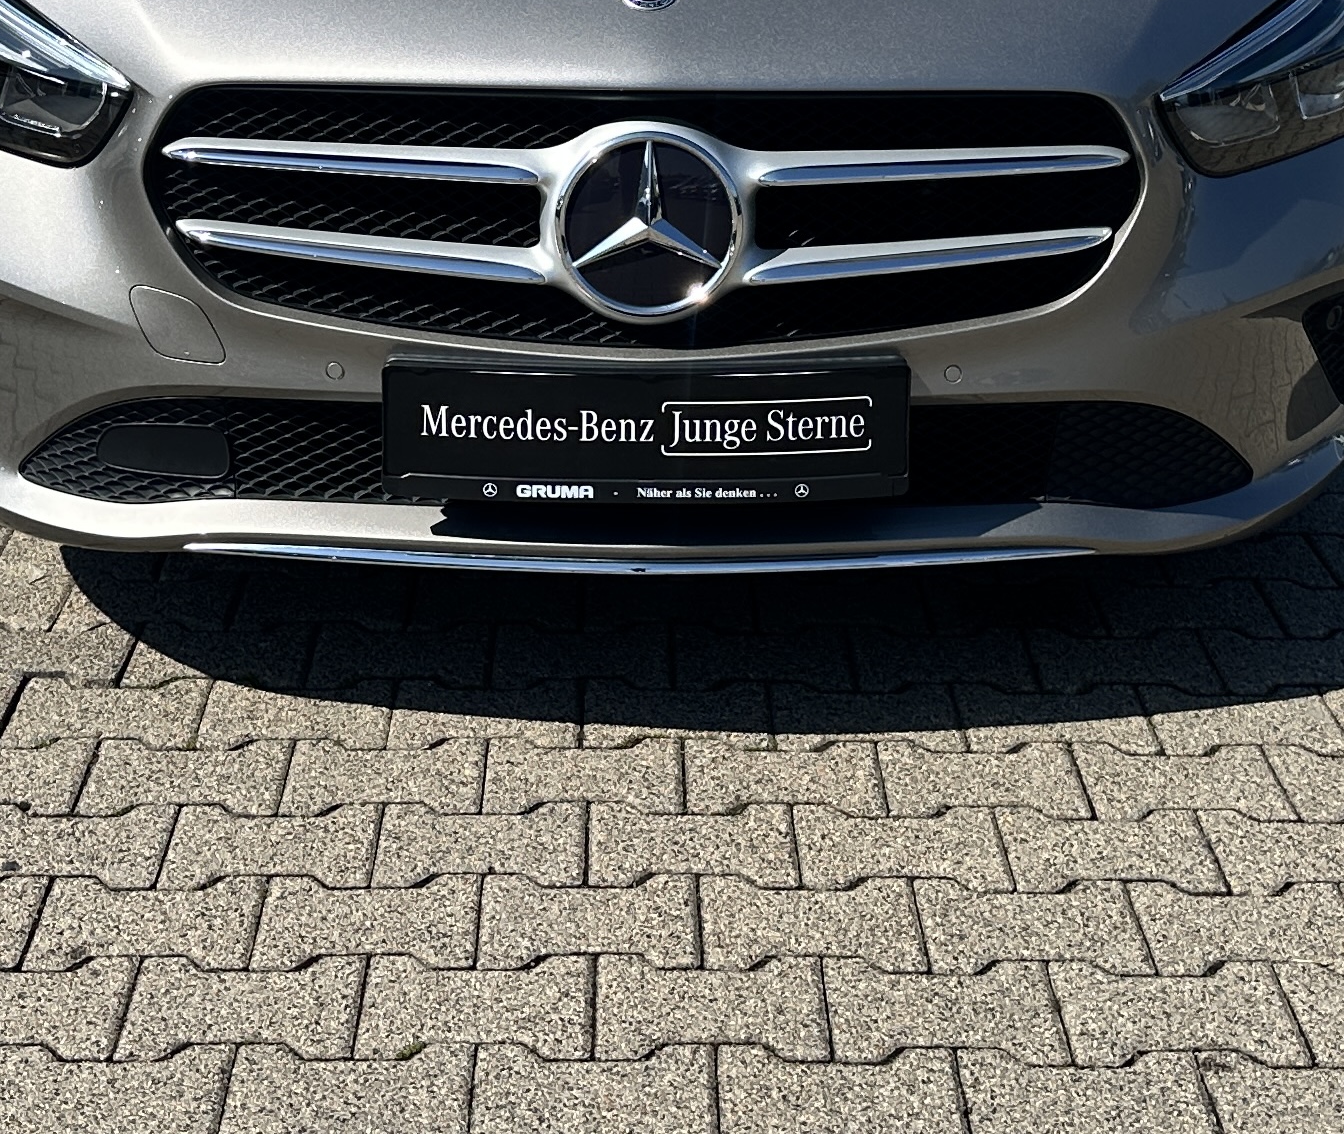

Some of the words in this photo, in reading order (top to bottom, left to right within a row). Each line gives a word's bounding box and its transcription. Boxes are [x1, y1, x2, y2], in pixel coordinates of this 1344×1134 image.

[420, 404, 655, 442] Mercedes-Benz
[669, 410, 757, 450] Junge
[766, 409, 865, 442] Sterne
[515, 484, 594, 499] GRUMA
[636, 487, 673, 498] Näher
[675, 487, 692, 498] als
[694, 487, 713, 498] Sie
